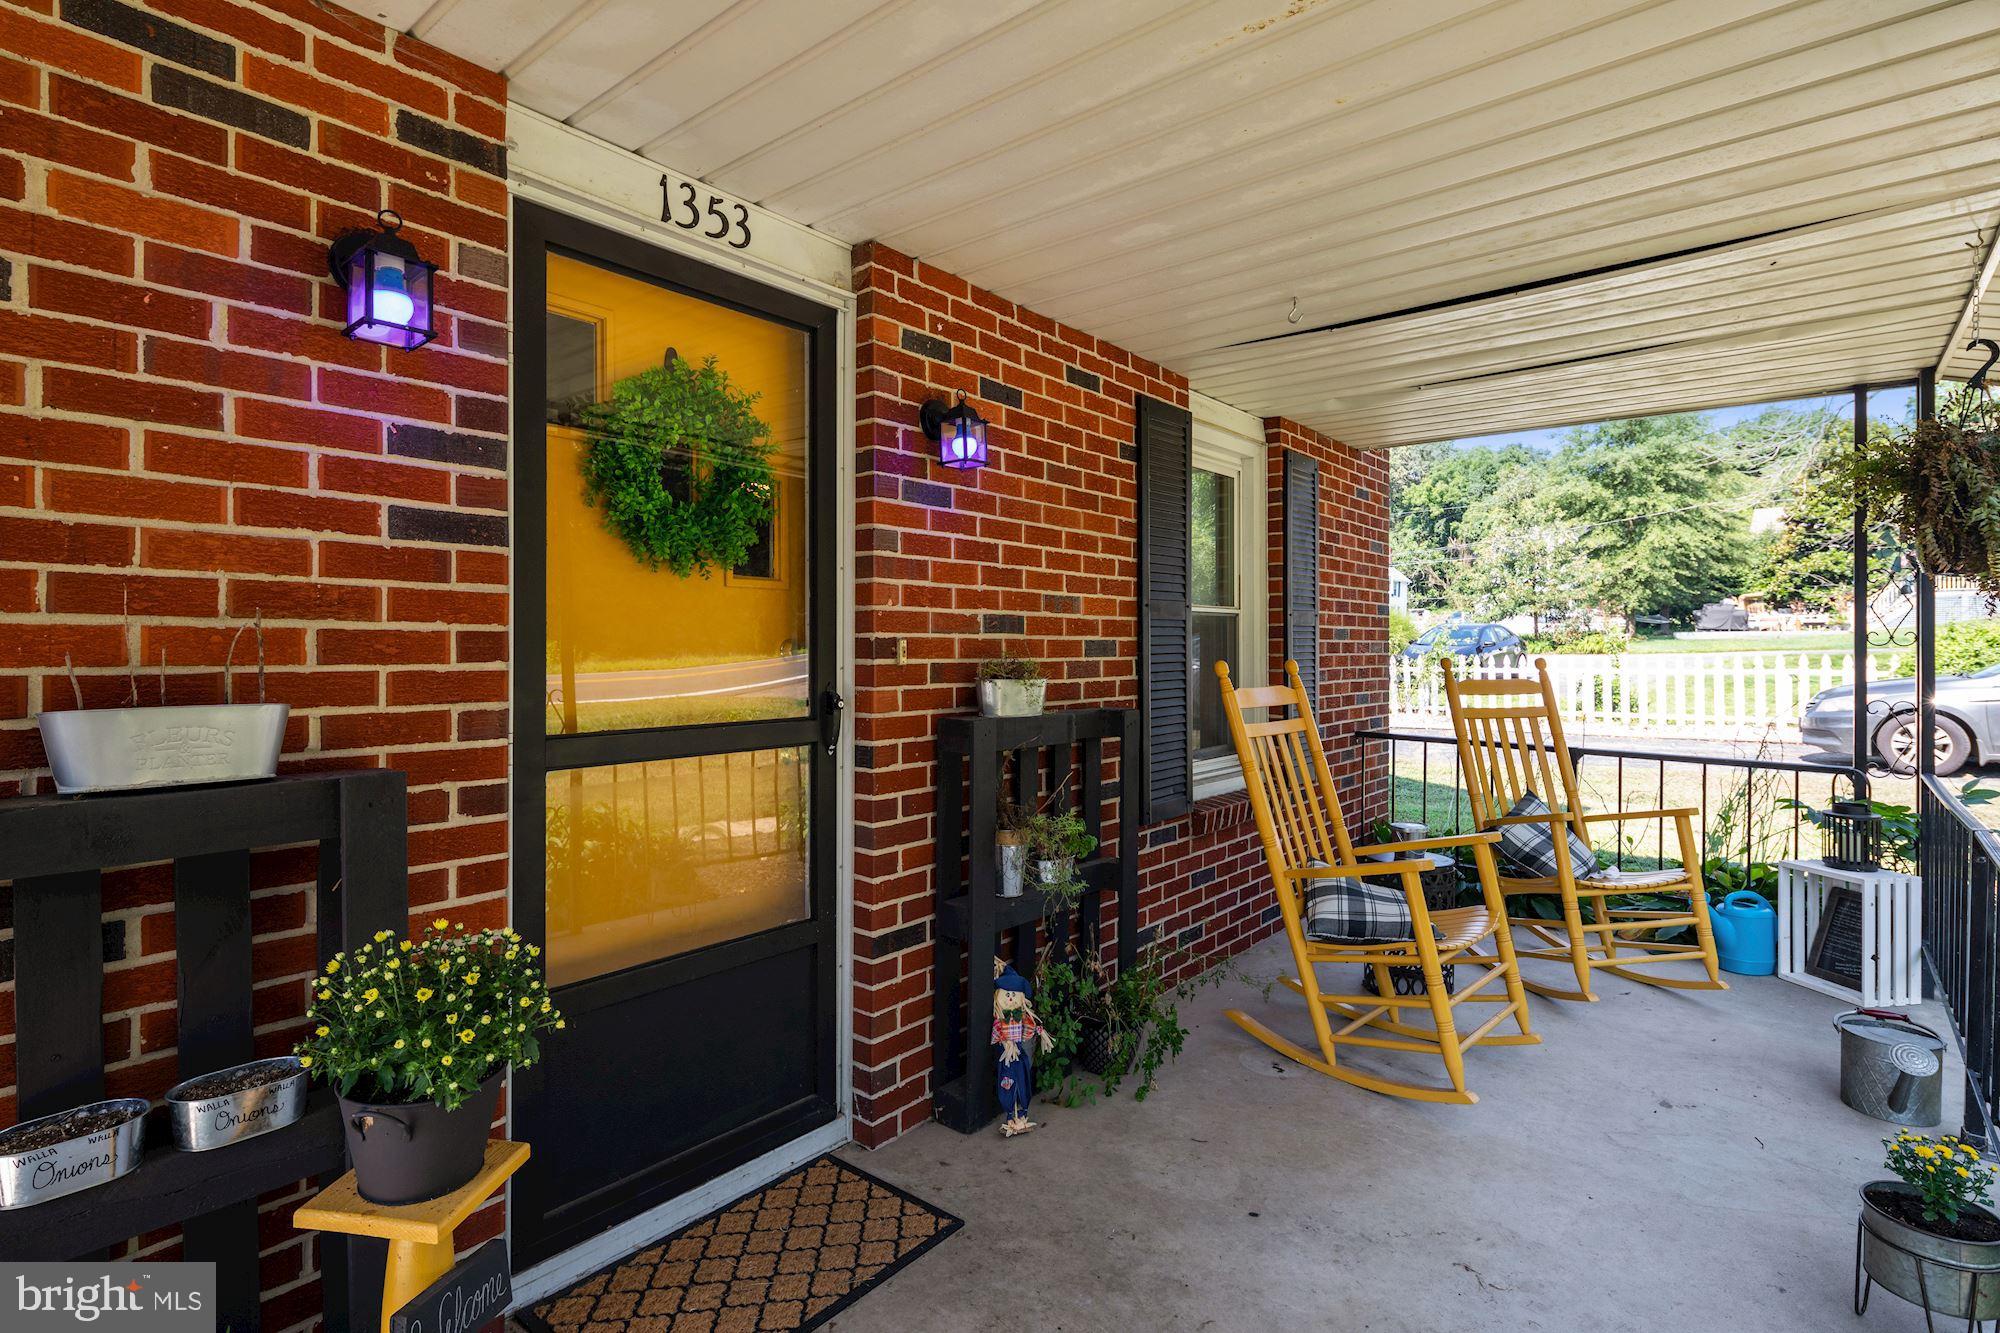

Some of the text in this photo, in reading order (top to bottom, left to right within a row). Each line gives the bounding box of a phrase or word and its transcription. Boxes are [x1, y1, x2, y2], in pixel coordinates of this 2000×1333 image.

[659, 173, 752, 249] 1353
[196, 1079, 295, 1113] WALLA WALLA
[214, 1102, 285, 1131] Onions
[12, 1148, 58, 1169] WALLA
[32, 1153, 118, 1190] Onions
